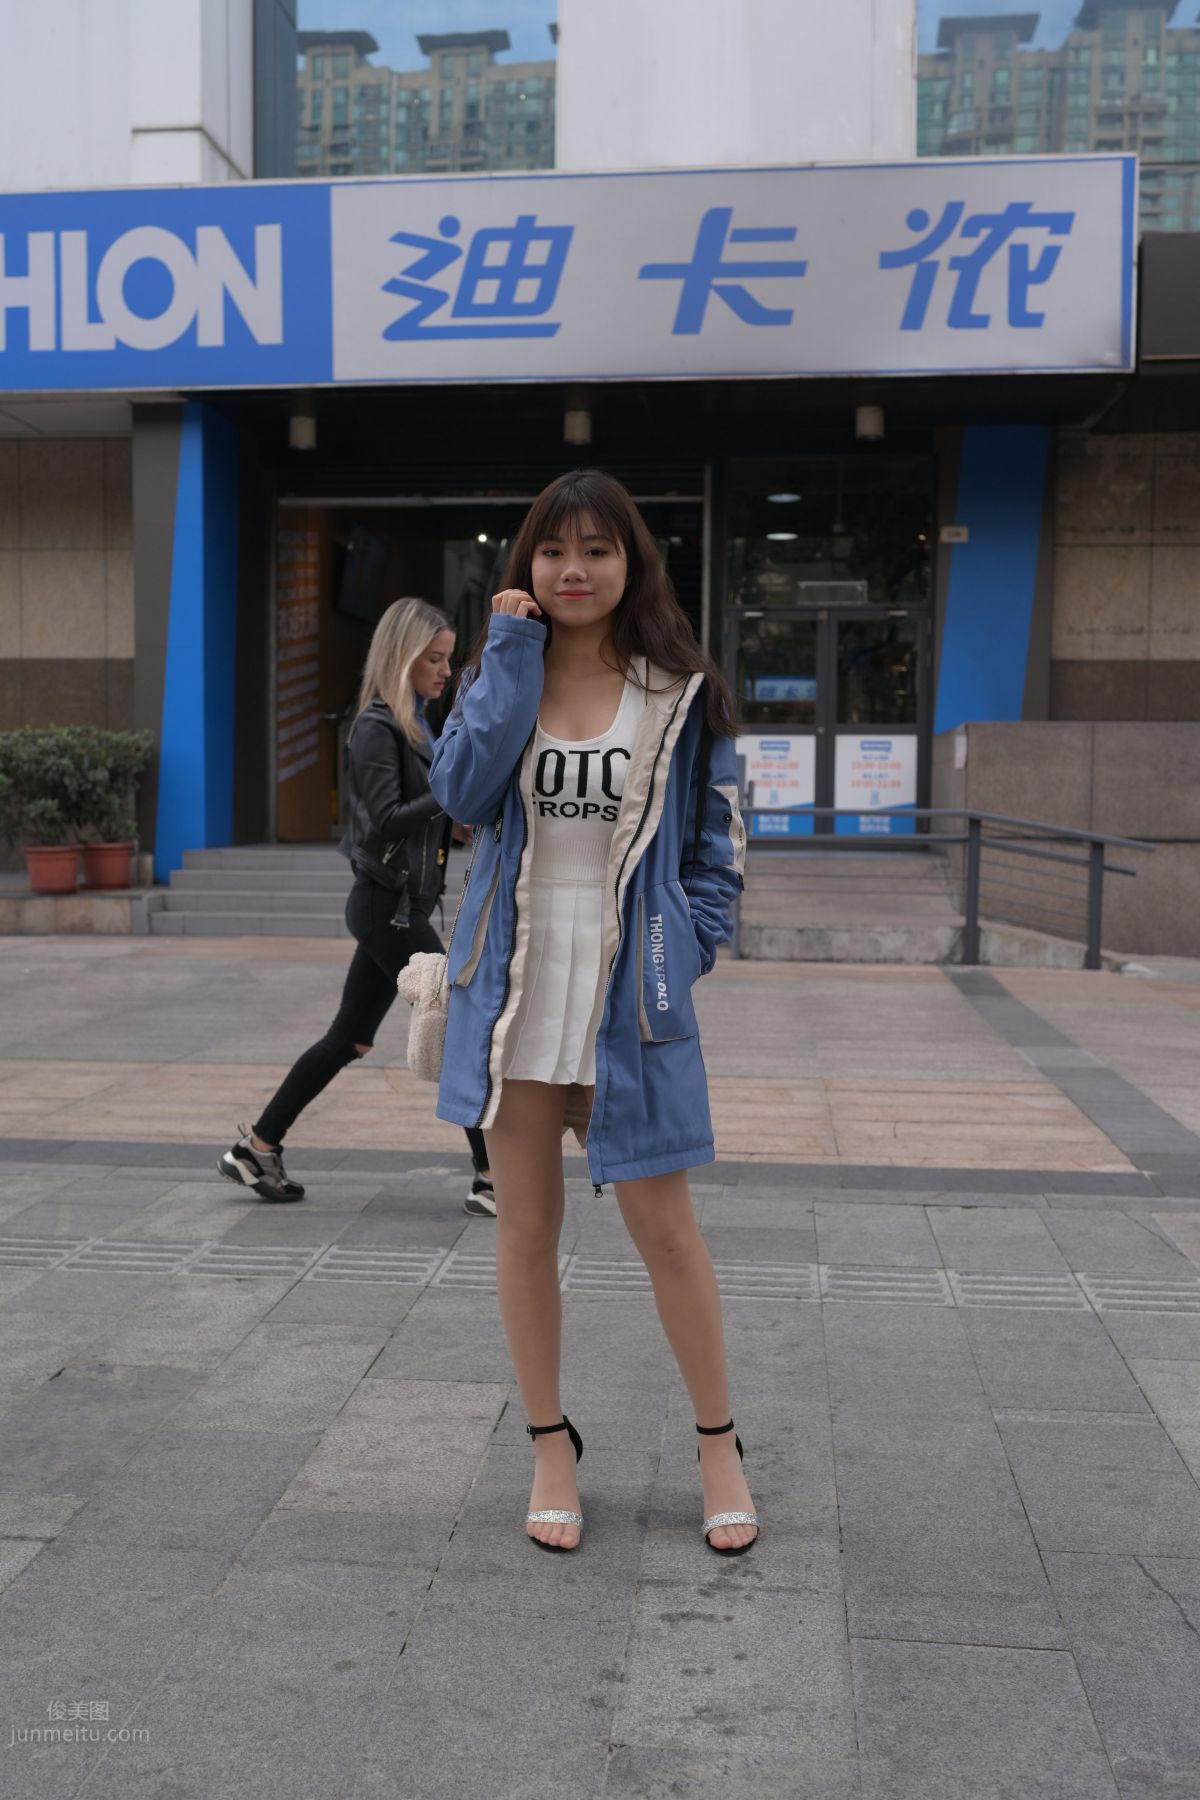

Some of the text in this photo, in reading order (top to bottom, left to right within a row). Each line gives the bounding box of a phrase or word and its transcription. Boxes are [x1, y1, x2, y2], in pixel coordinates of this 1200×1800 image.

[0, 224, 283, 351] HLON
[381, 201, 1075, 341] 迪卡侬
[531, 748, 631, 802] OTC
[532, 801, 619, 822] ROPS
